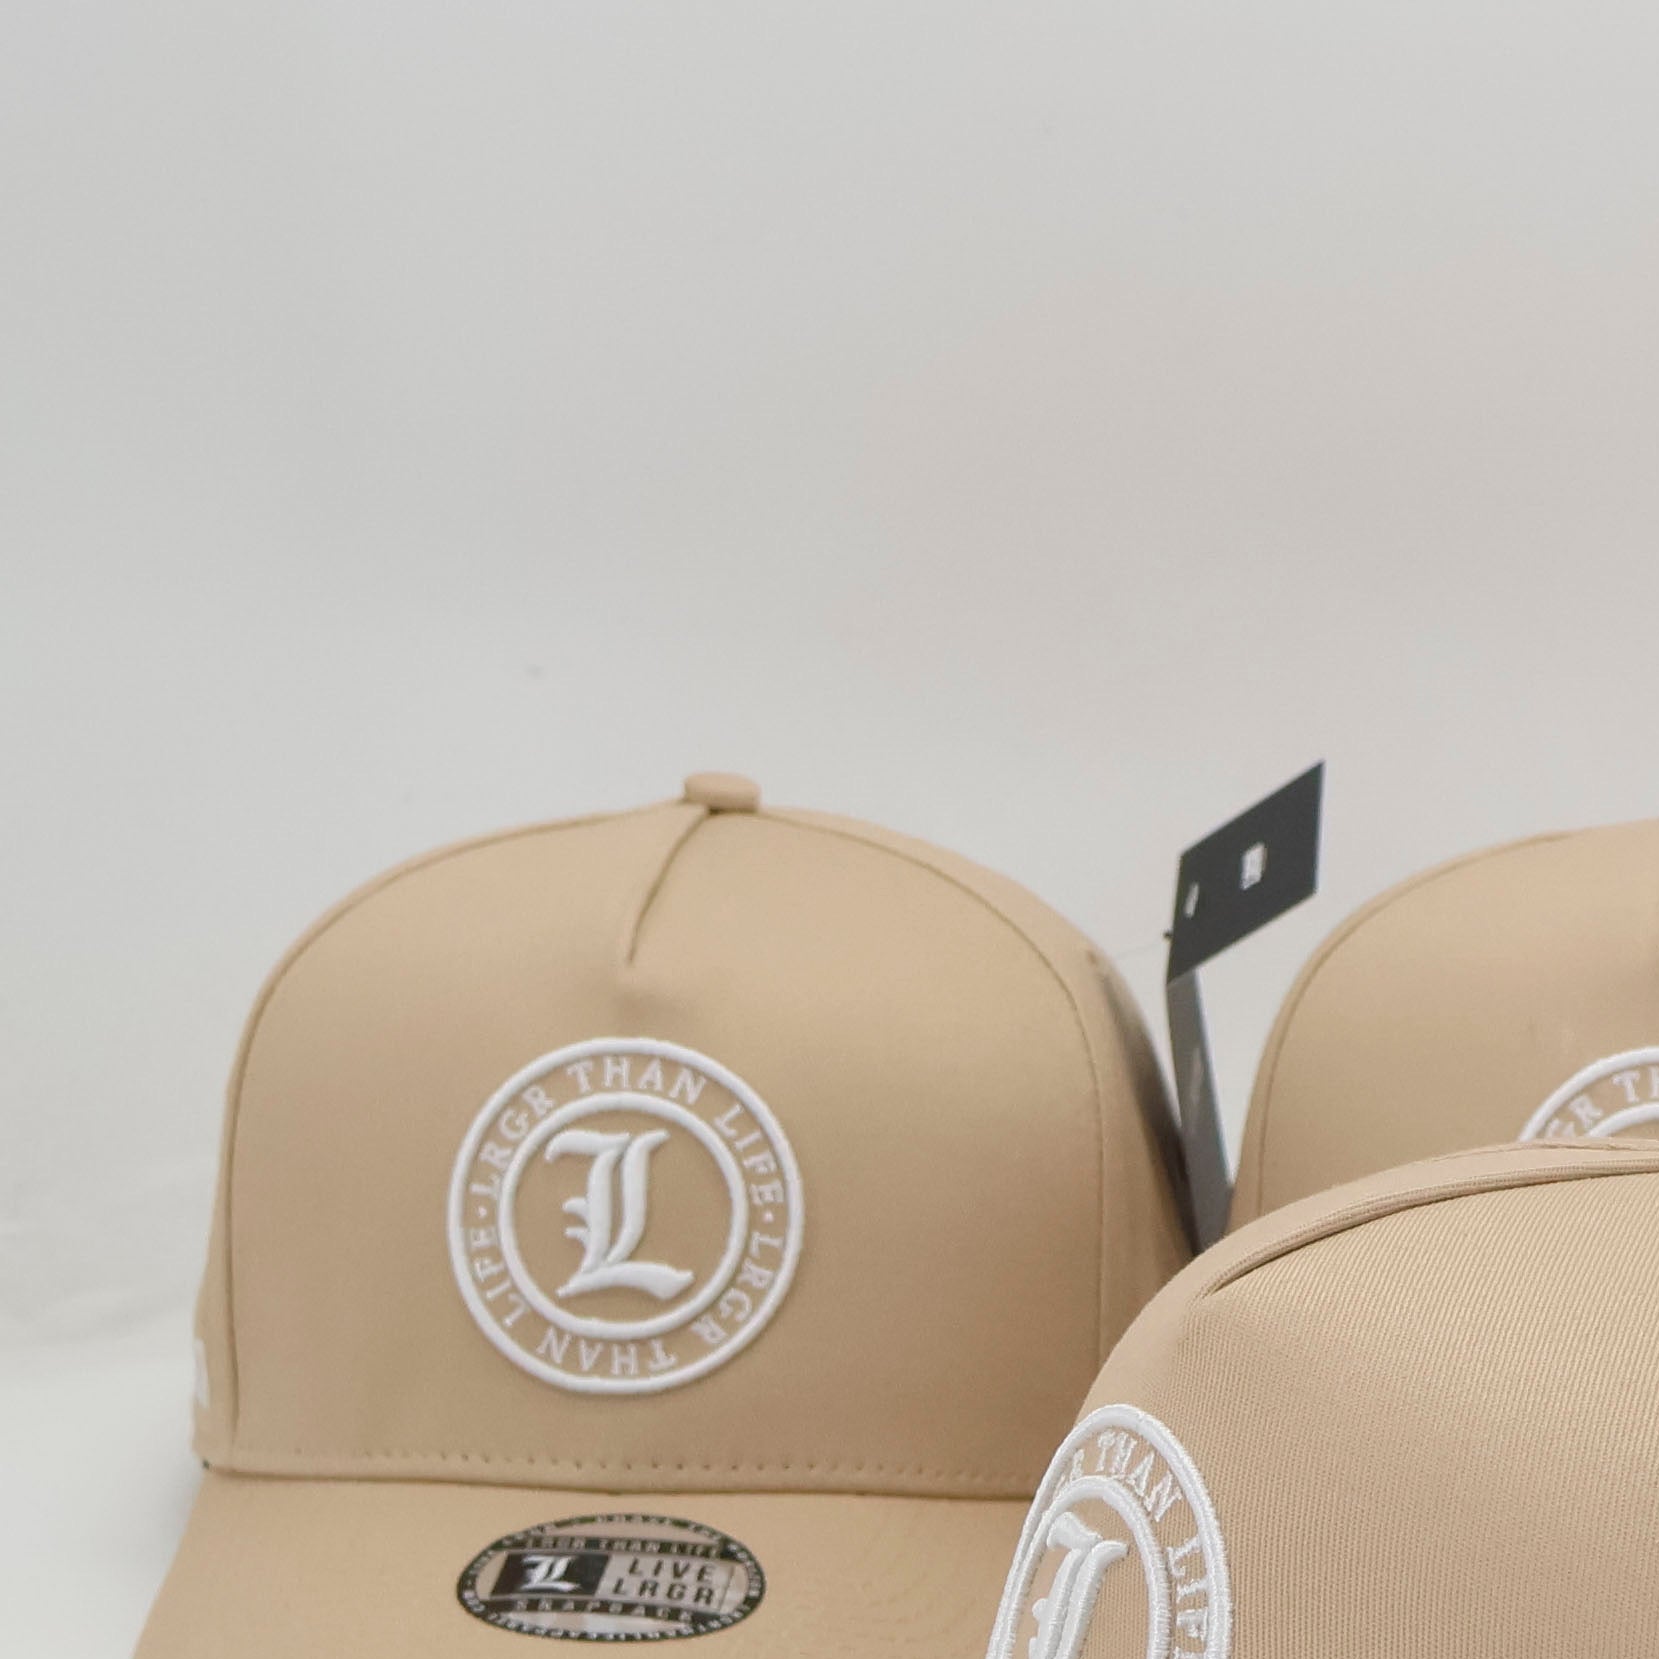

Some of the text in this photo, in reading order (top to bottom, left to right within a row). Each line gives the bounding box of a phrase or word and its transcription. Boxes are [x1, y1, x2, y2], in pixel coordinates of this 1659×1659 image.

[471, 1056, 784, 1205] LRGR THAN LIFE
[471, 1227, 784, 1376] LRGR THAN LIFE
[1096, 1430, 1183, 1522] THAN
[629, 1557, 716, 1583] LIVE
